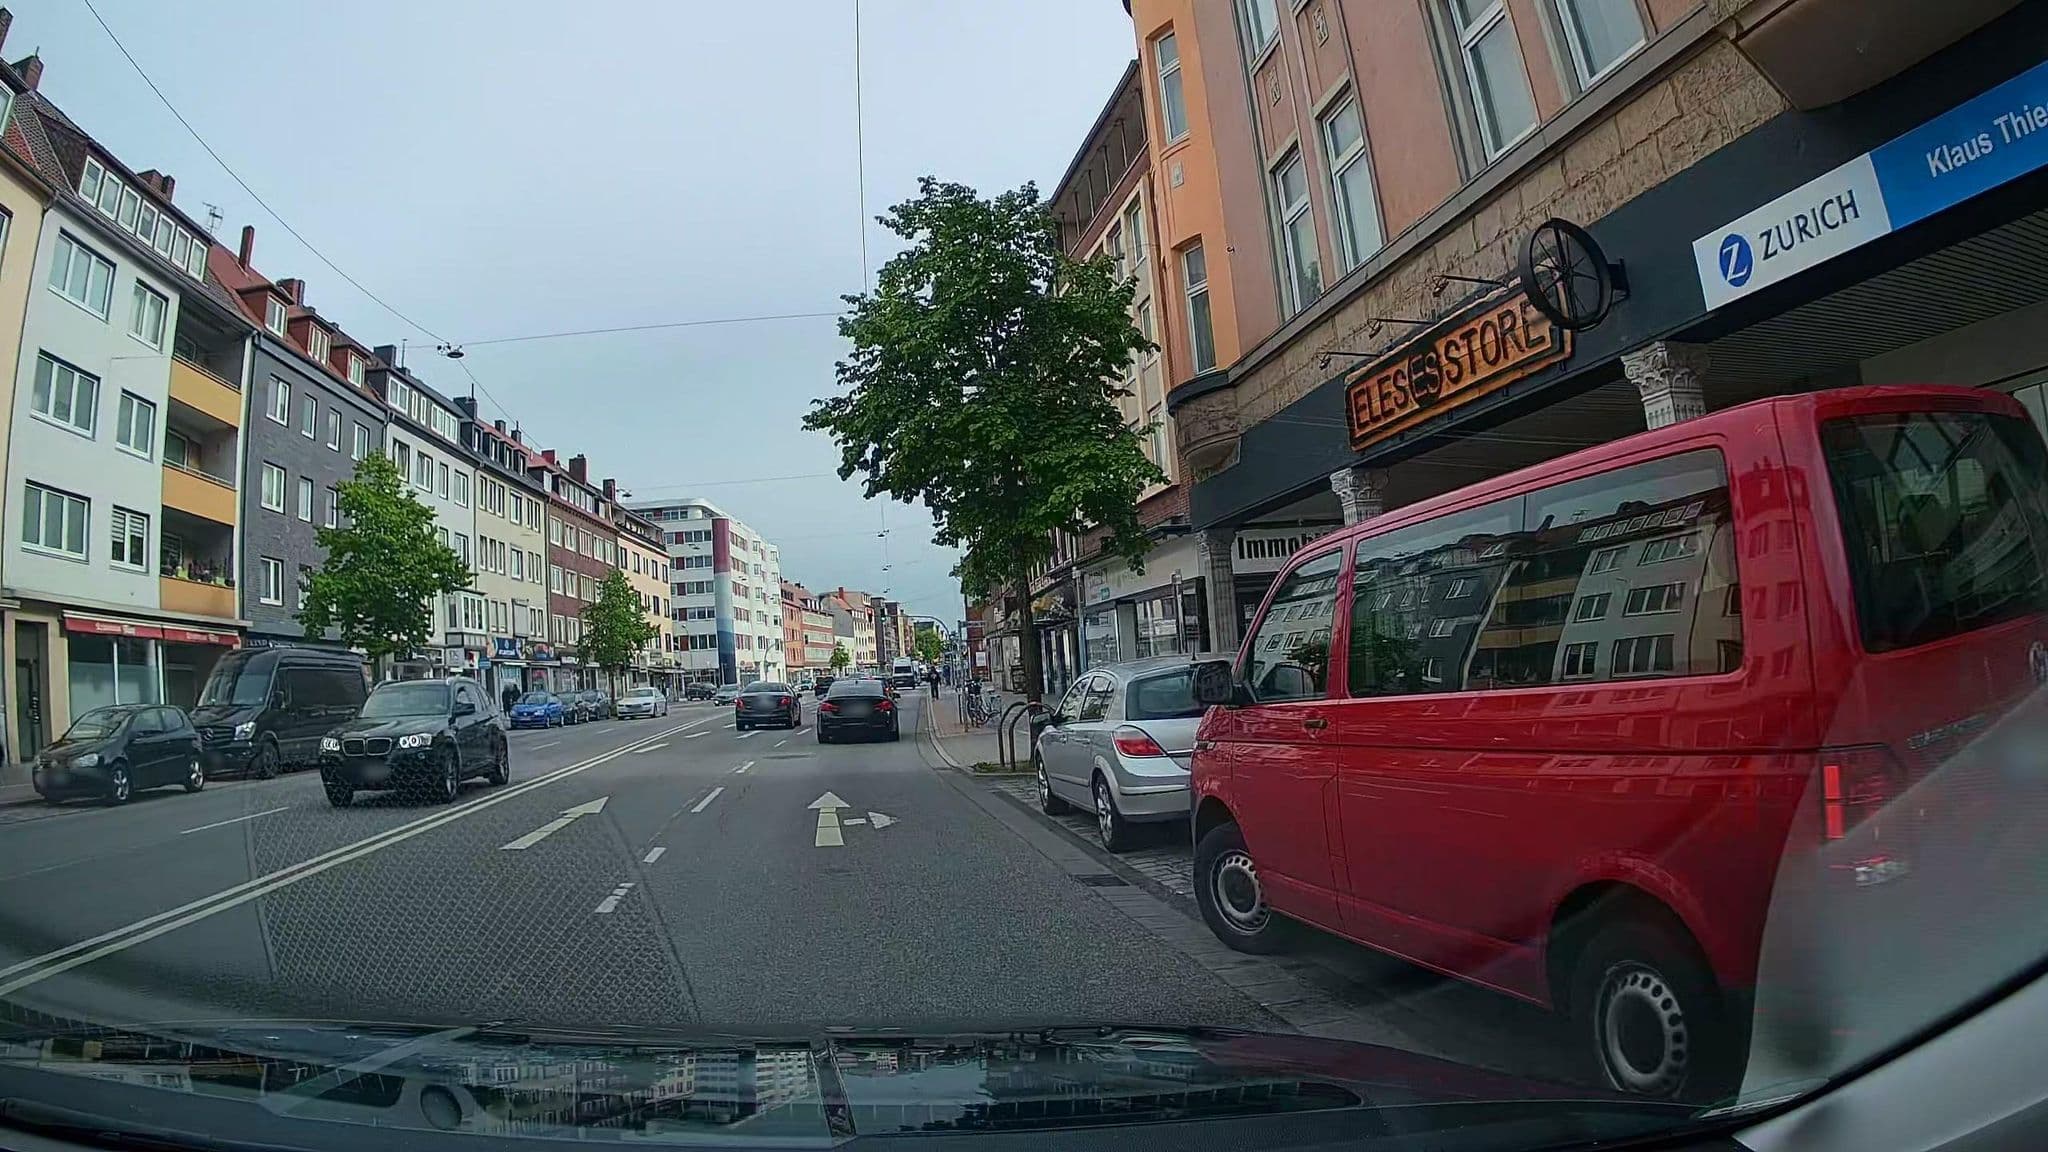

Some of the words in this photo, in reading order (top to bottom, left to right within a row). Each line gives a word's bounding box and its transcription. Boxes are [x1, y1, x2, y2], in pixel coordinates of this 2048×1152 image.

[1926, 132, 1994, 178] Klaus
[1993, 100, 2048, 144] Thie
[1757, 189, 1860, 262] ZURICH
[1443, 300, 1546, 385] STORE
